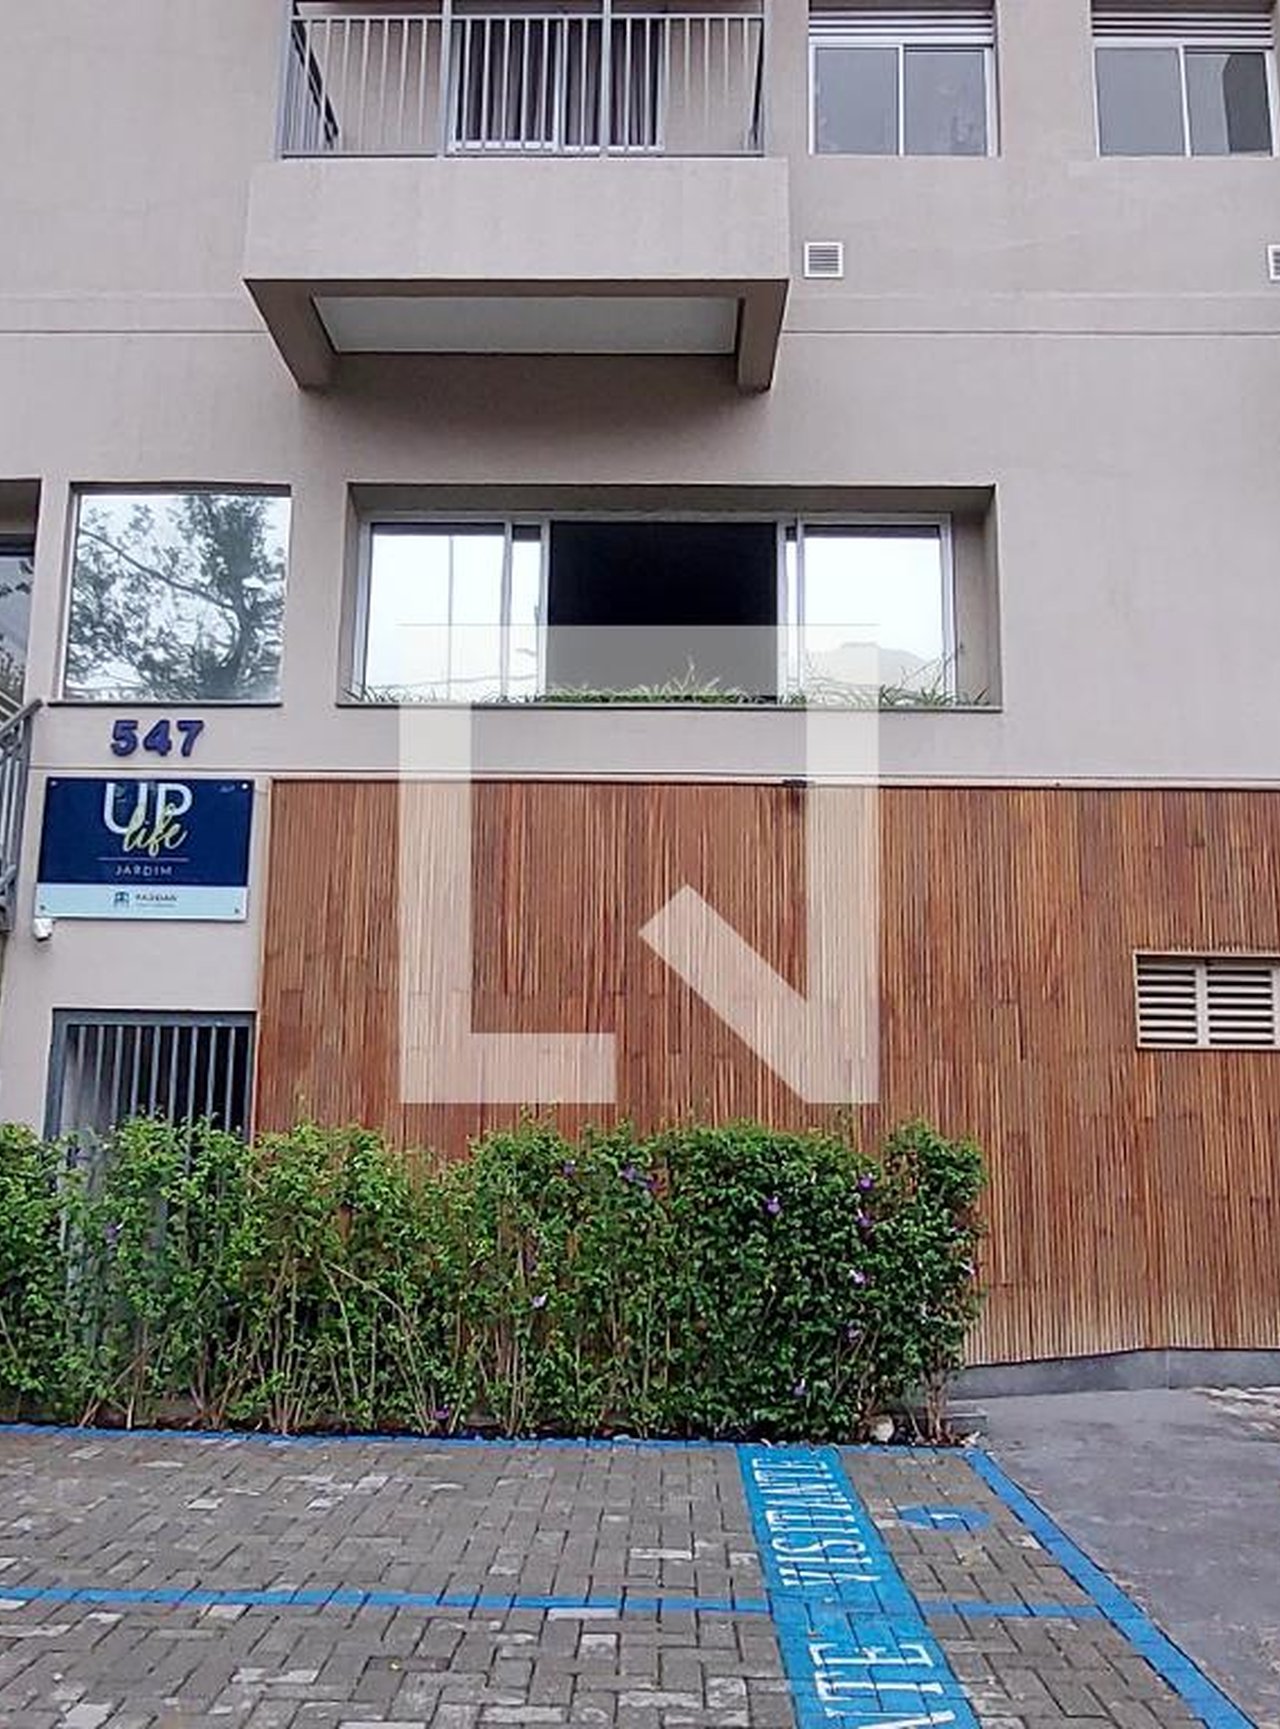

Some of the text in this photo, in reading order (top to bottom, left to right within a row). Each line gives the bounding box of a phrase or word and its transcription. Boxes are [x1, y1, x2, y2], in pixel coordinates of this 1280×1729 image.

[111, 720, 205, 757] 547
[104, 782, 193, 834] UP
[123, 803, 188, 856] life
[115, 866, 173, 877] JARDIM
[753, 1457, 879, 1586] VISITANTE
